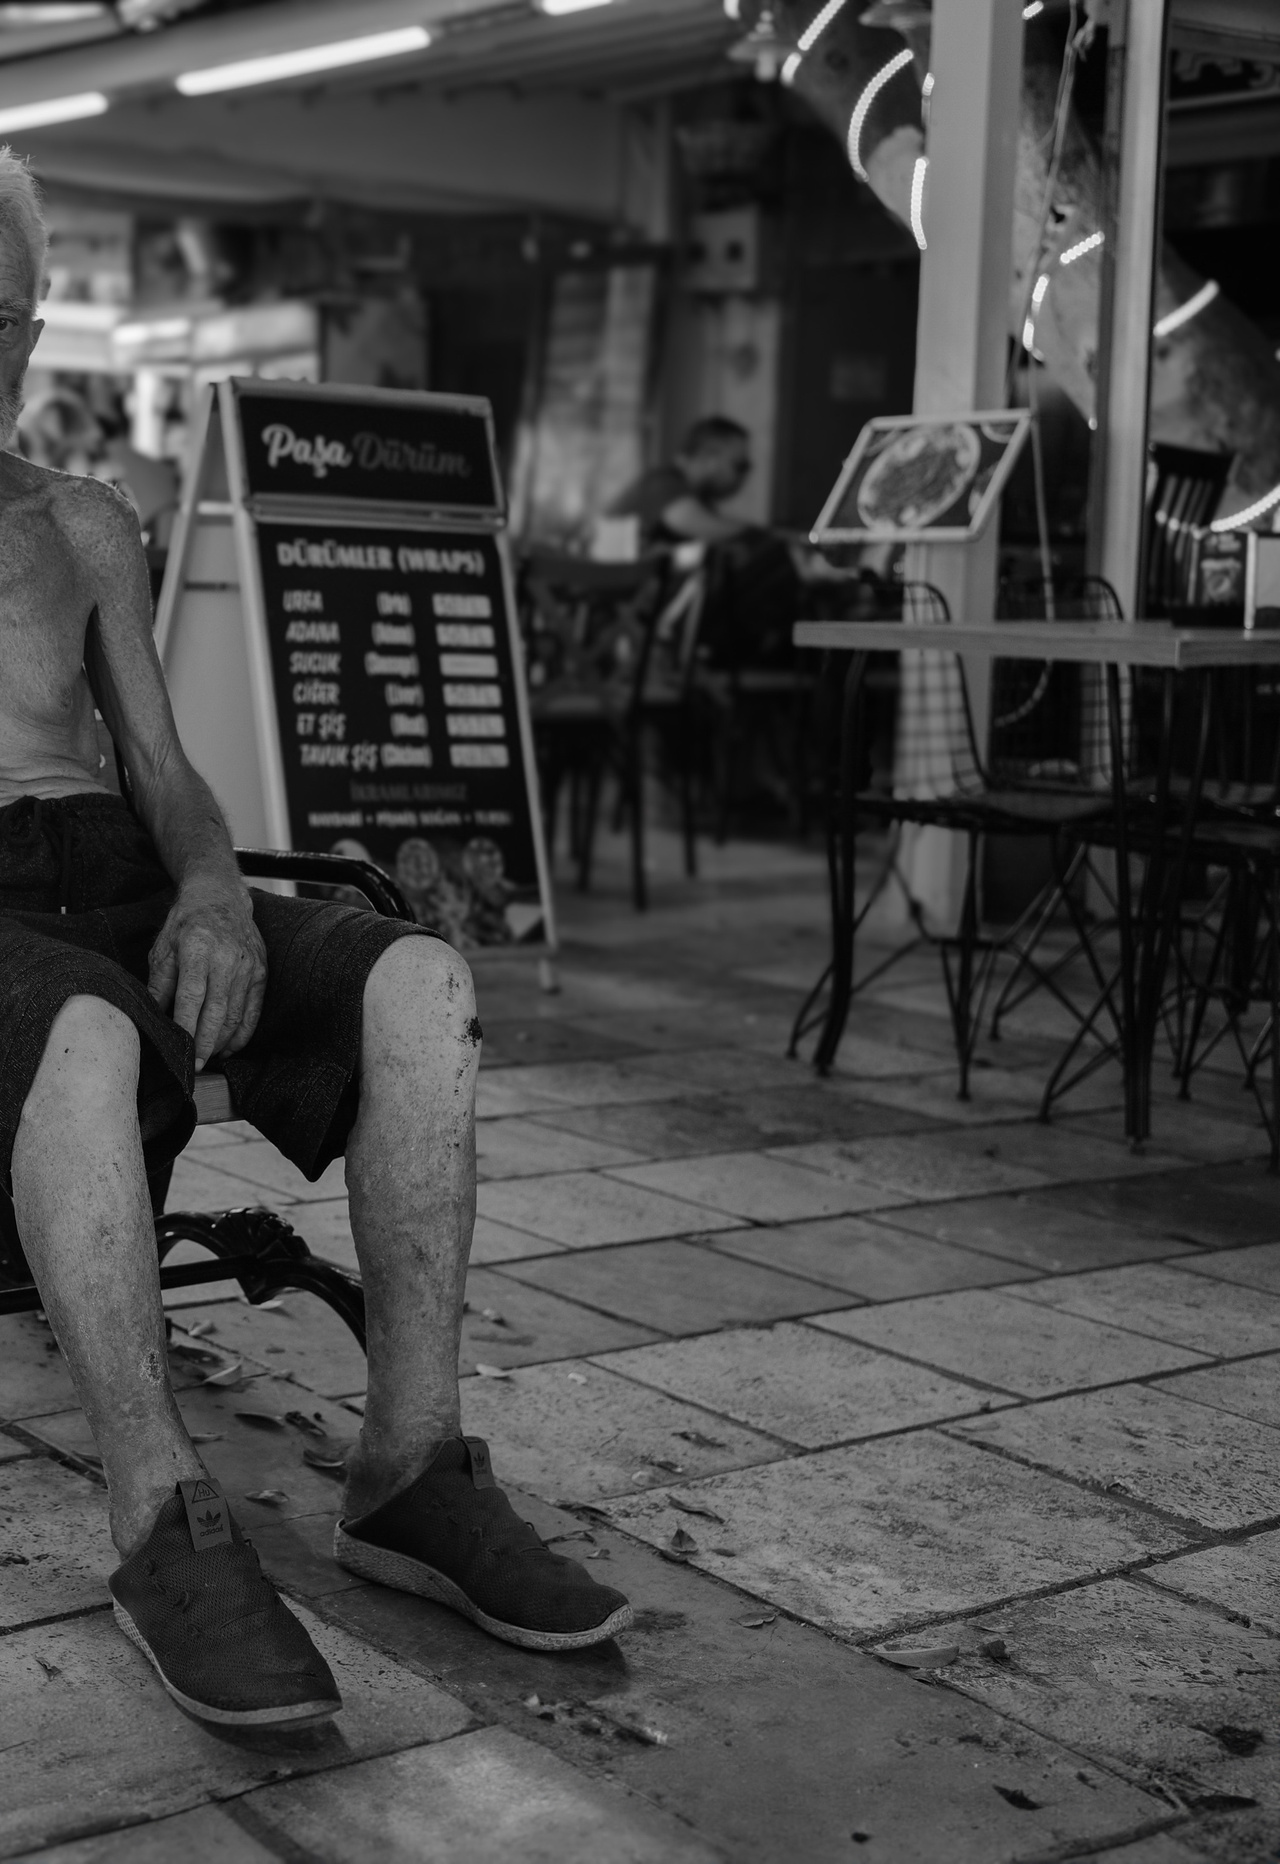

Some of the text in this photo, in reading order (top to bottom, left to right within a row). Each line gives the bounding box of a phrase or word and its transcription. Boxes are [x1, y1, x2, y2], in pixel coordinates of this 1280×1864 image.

[262, 424, 471, 478] Paşa Dürüm
[277, 539, 485, 576] DÜRÜMLER (WRAPS)
[285, 621, 340, 643] ADANA
[289, 652, 341, 674] SUCUK
[296, 713, 316, 736] ET
[300, 744, 349, 767] TAVUK
